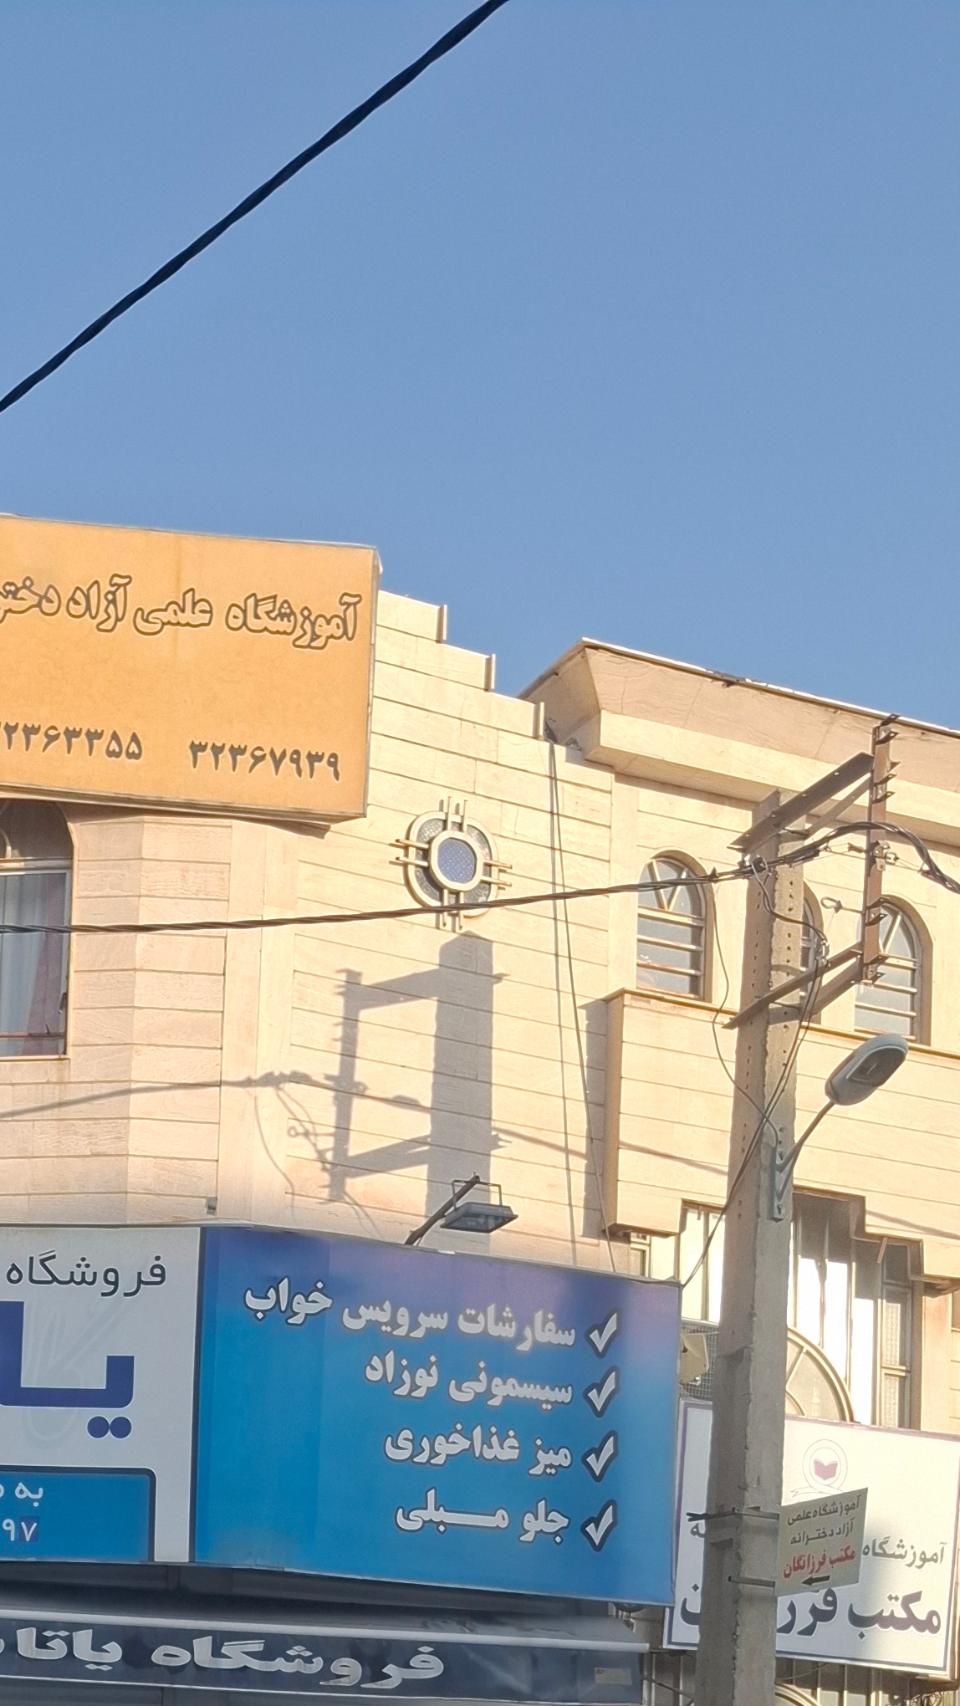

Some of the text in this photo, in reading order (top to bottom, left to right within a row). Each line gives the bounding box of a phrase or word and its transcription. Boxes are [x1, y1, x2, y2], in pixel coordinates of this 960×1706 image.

[66, 573, 132, 632] آزاد
[133, 588, 214, 636] علمی
[225, 591, 362, 650] آموزشگاه
[189, 740, 341, 782] ۳۲۳۶۷۹۳۹
[5, 1250, 167, 1298] فروشگاه
[244, 1276, 576, 1352] سفارشات سرویس خواب
[364, 1351, 573, 1411] سیسمونی نوزاد
[384, 1423, 572, 1475] میز غذاخوری
[14, 1482, 44, 1507] به
[396, 1487, 570, 1544] جلو مبلی
[787, 1494, 862, 1526] آموزشگاه علمی
[790, 1517, 856, 1546] آزاد دخترانه
[862, 1536, 947, 1569] آموزشگاه
[783, 1544, 857, 1579] مکتب فرزانگان
[847, 1590, 942, 1640] مکتب
[151, 1635, 444, 1689] فروشگاه
